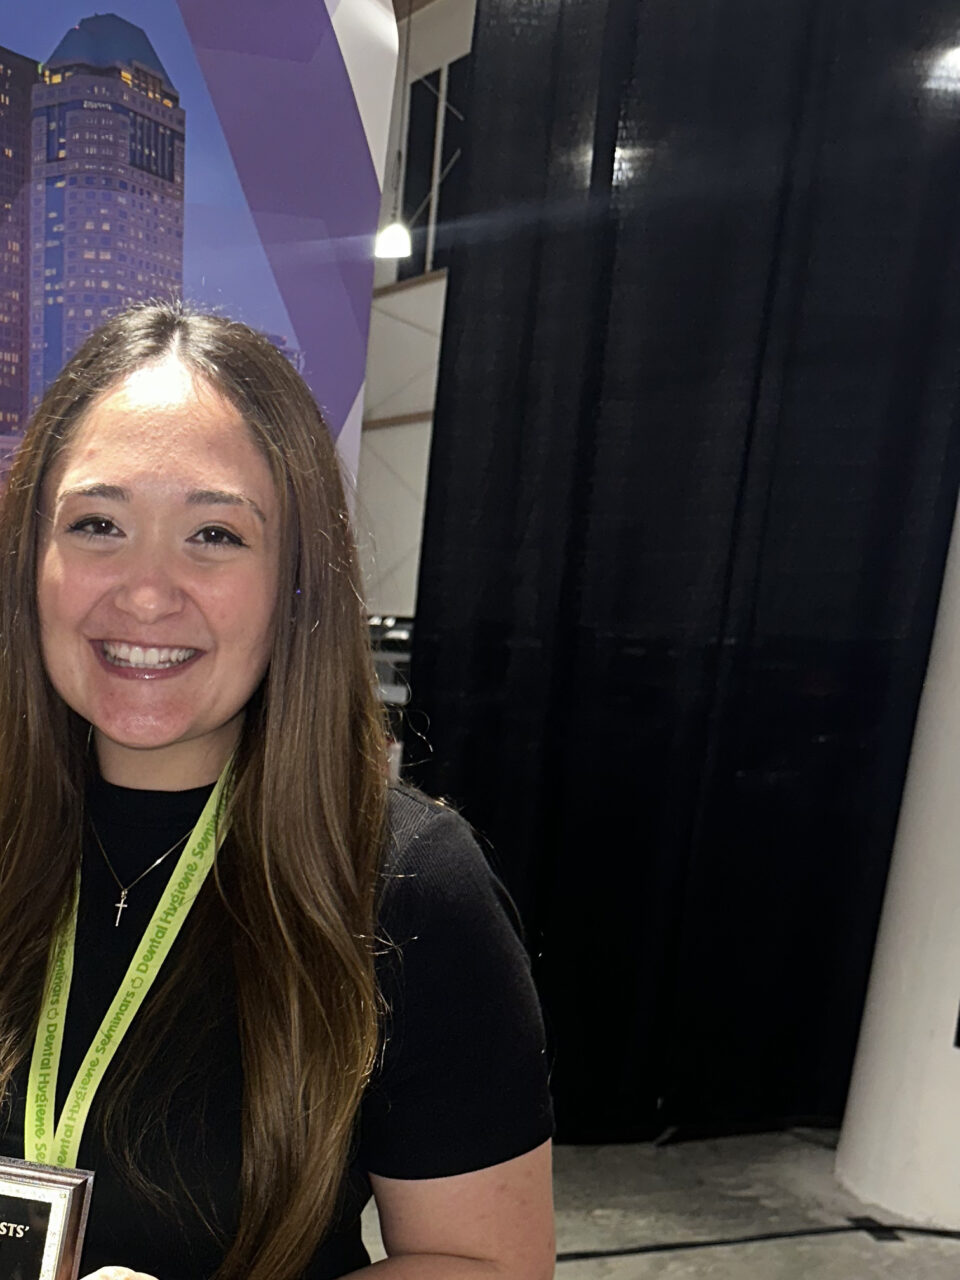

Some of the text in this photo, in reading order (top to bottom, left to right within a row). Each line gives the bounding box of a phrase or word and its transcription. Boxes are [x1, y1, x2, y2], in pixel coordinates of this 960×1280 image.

[39, 1022, 58, 1070] Dental
[57, 1123, 75, 1167] ental
[67, 1057, 100, 1122] Hygiene
[95, 990, 136, 1055] Seminars
[135, 924, 168, 975] Dental
[160, 862, 198, 925] Hygiene
[34, 1072, 51, 1139] Hygiene
